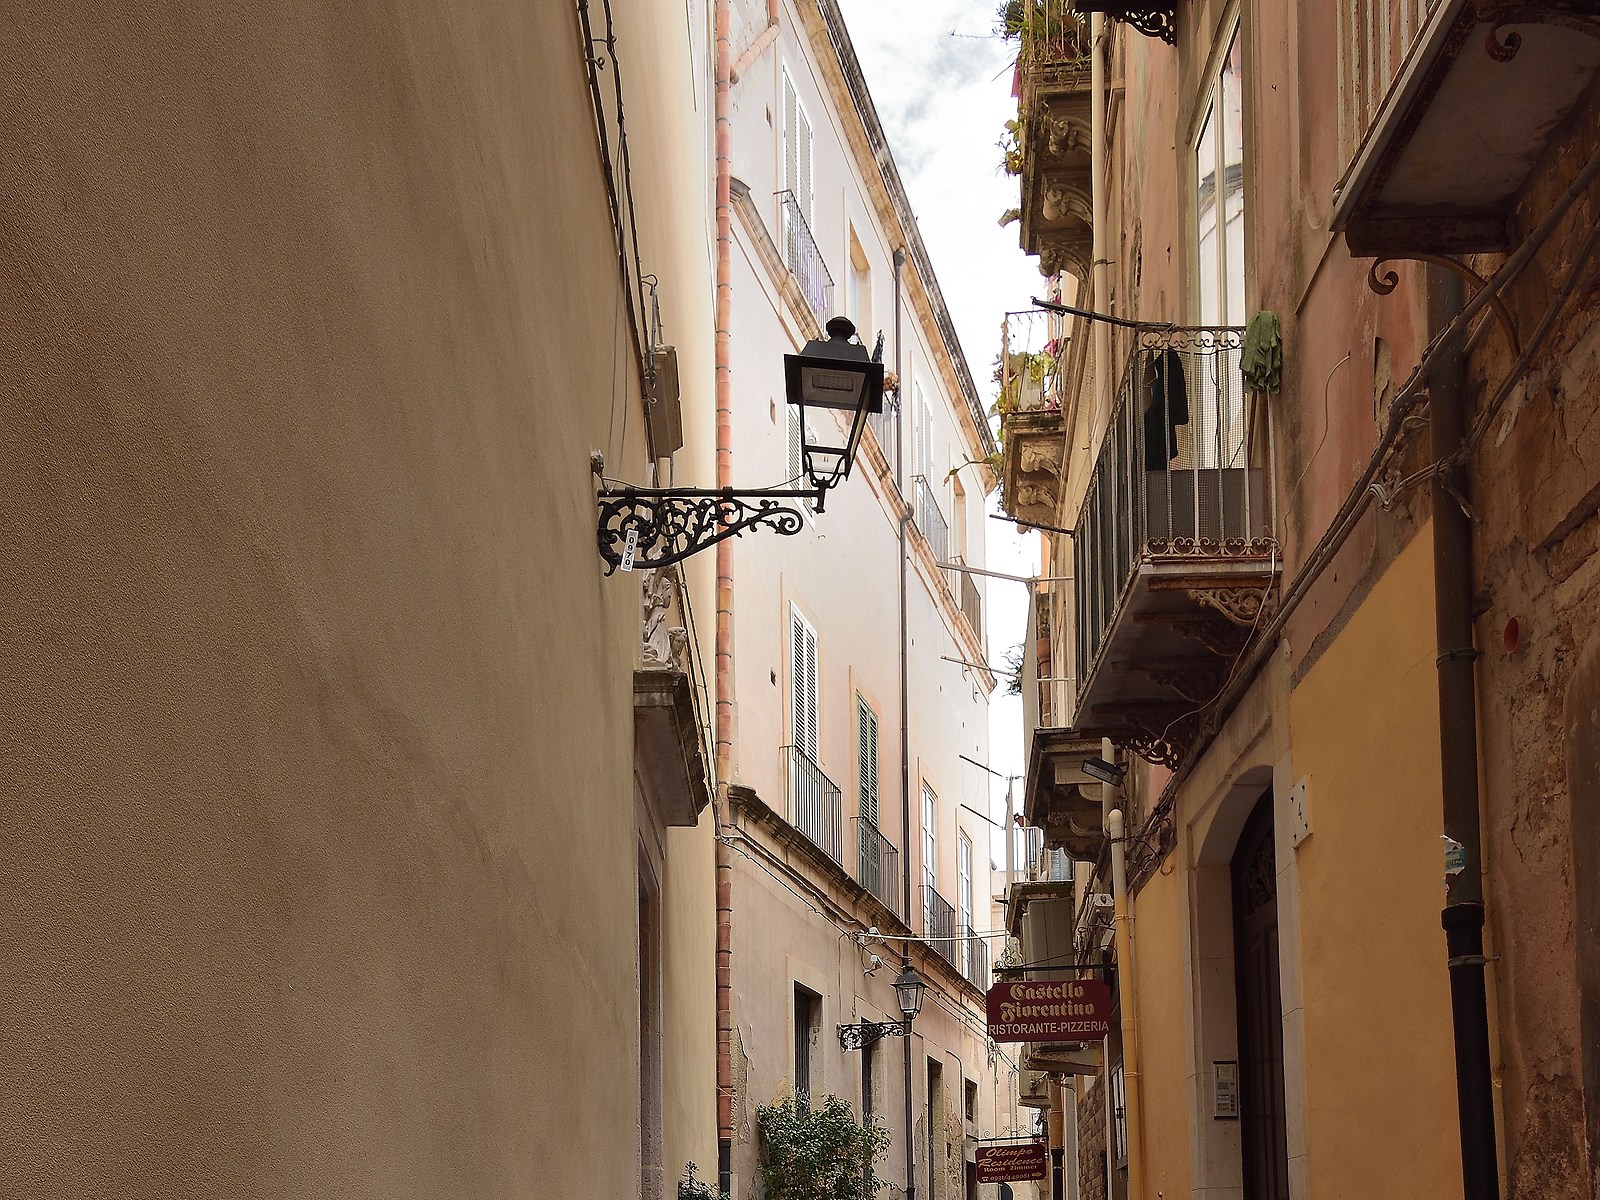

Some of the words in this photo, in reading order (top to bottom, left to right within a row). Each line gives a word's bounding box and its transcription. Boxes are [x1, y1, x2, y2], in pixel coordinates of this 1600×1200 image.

[625, 537, 634, 565] 0970
[1009, 982, 1085, 1000] Castello
[1000, 1000, 1095, 1022] Fiorentino
[988, 1021, 1110, 1035] RISTORANTE-PIZZERIA
[985, 1148, 1033, 1158] Olimpo
[977, 1157, 1043, 1167] Residence
